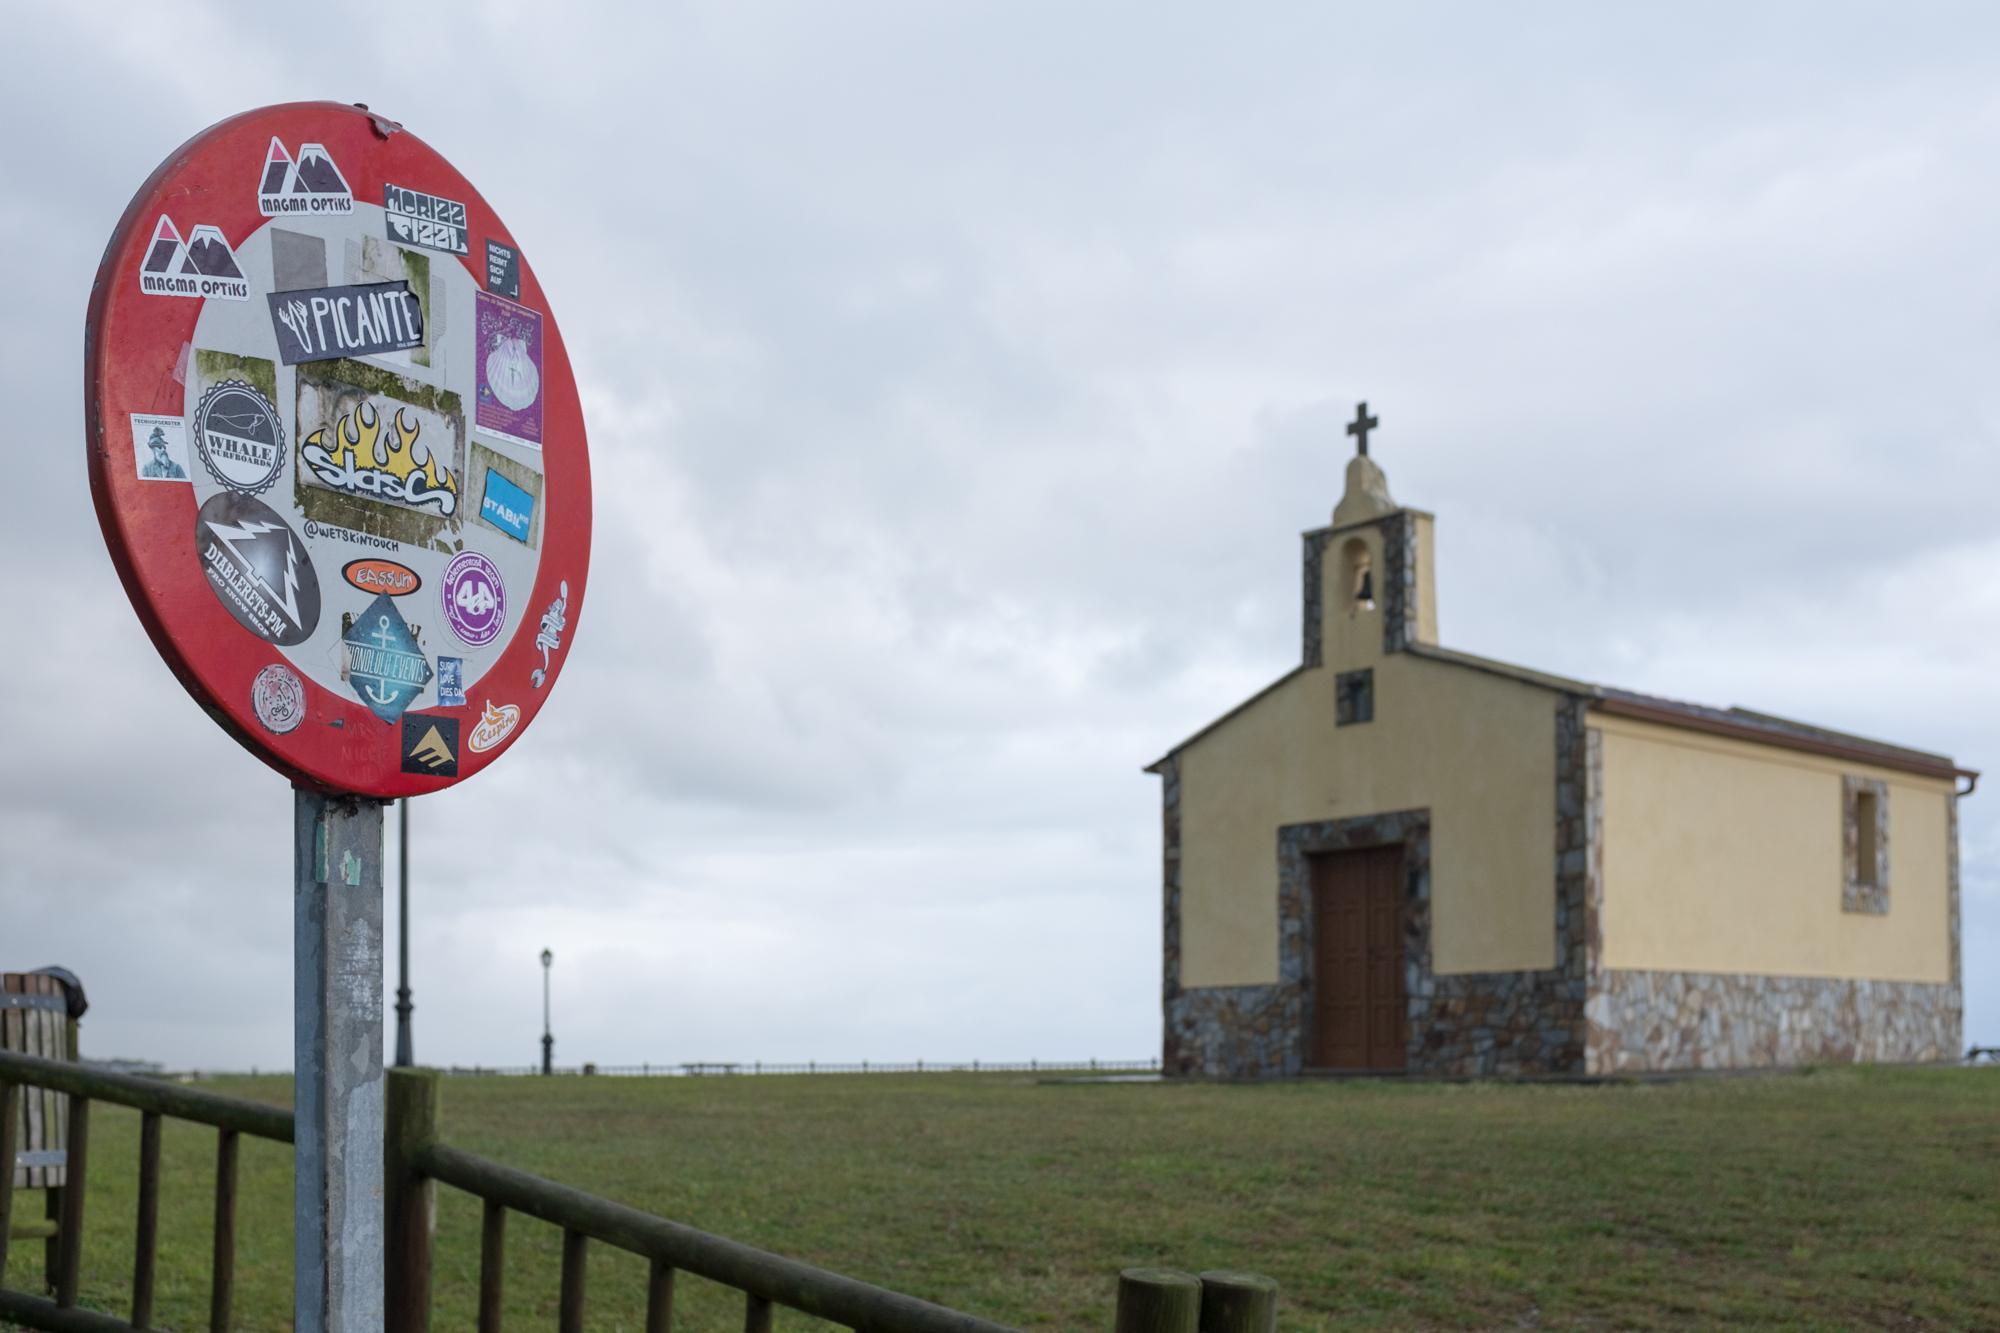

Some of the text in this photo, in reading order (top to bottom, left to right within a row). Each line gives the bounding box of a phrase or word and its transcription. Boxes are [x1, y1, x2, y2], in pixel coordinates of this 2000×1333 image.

[262, 198, 308, 212] MAGMA
[385, 185, 466, 228] MORIZZ
[489, 244, 511, 259] NICHTS
[489, 254, 507, 268] REIMT
[490, 265, 505, 277] SICH
[490, 275, 502, 285] AUF
[143, 276, 198, 293] MAGMA
[310, 291, 421, 351] PICANTE
[208, 434, 272, 461] WHALE
[210, 448, 272, 468] SURFBOARDS
[204, 542, 287, 639] DIABLERETS-PM
[207, 566, 270, 637] PRO SNOW SHOP
[392, 654, 426, 682] EVENTS
